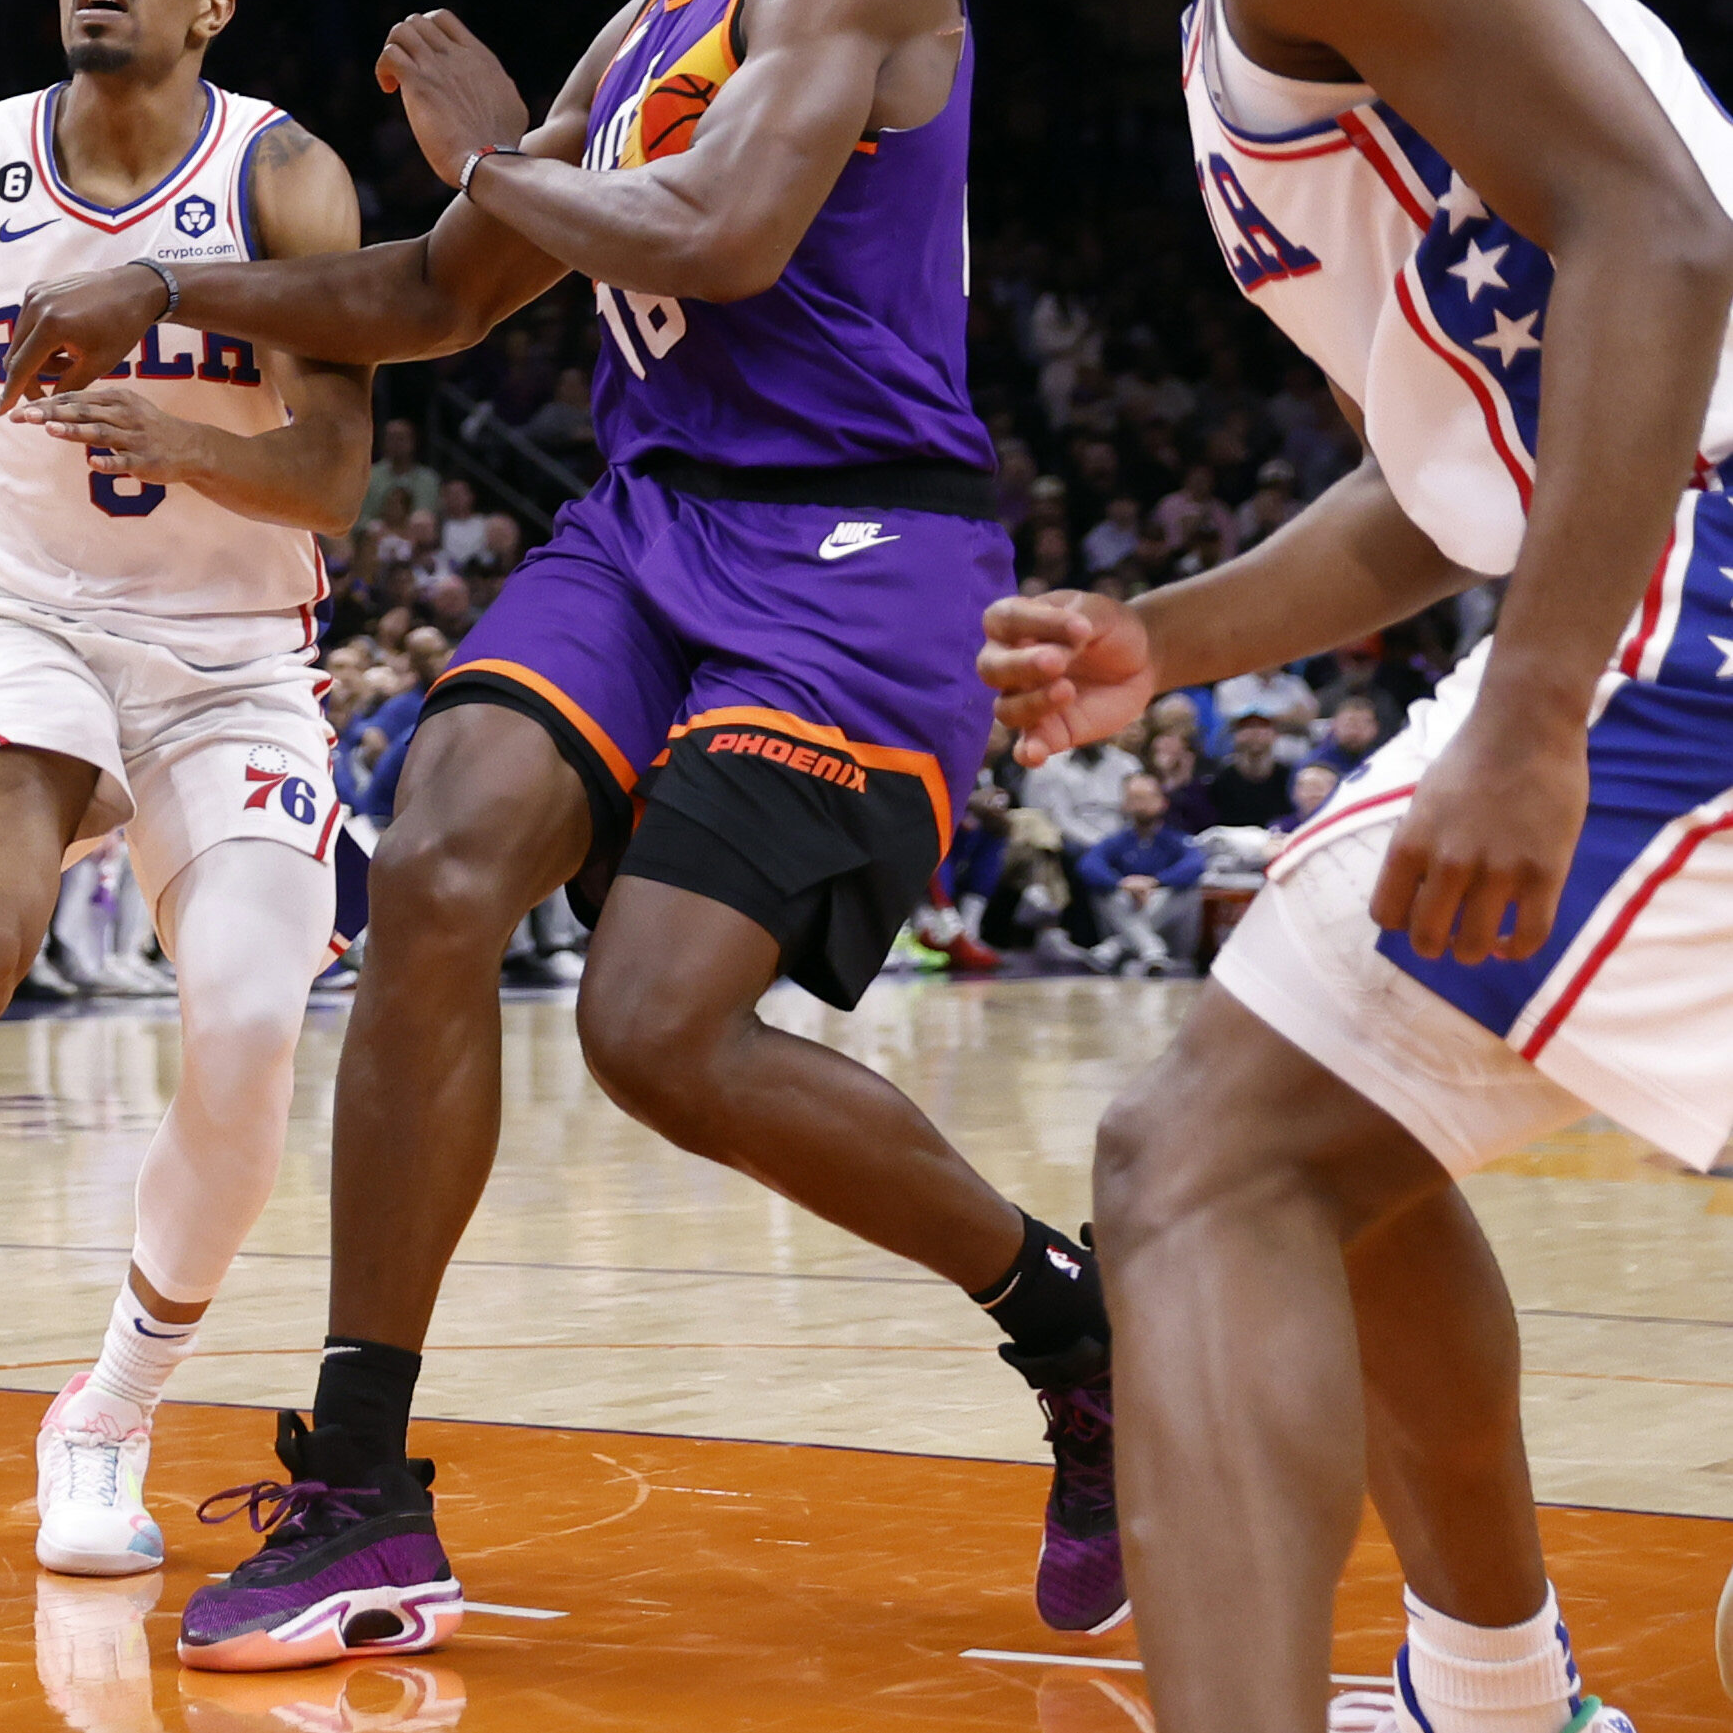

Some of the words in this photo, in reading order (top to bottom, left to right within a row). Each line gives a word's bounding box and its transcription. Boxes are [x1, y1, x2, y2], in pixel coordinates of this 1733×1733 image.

[3, 166, 27, 198] 6
[157, 242, 236, 260] crypto.com
[831, 521, 883, 544] NIKE
[707, 732, 868, 794] PHOENIX
[243, 765, 317, 826] 76
